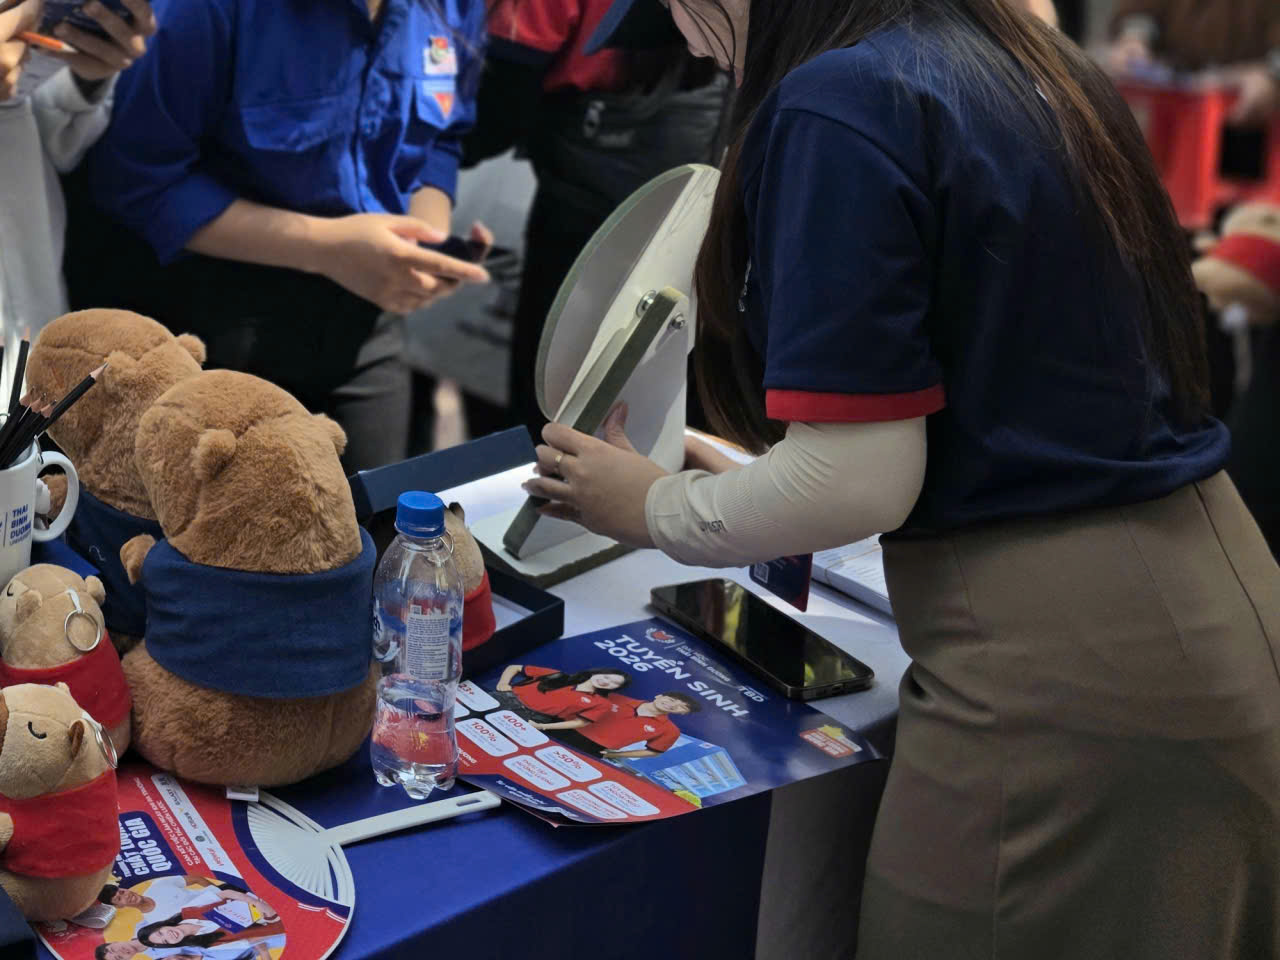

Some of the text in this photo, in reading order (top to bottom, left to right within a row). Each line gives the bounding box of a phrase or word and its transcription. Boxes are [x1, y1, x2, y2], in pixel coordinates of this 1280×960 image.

[594, 640, 654, 672] 2026
[616, 634, 750, 717] TUYỂN SINH
[739, 685, 764, 702] TBD
[472, 722, 496, 742] 100%
[502, 713, 526, 732] 400+
[553, 750, 582, 770] >50%
[124, 818, 150, 838] GIA
[124, 852, 150, 876] CHẤT
[138, 840, 172, 872] QUỐC
